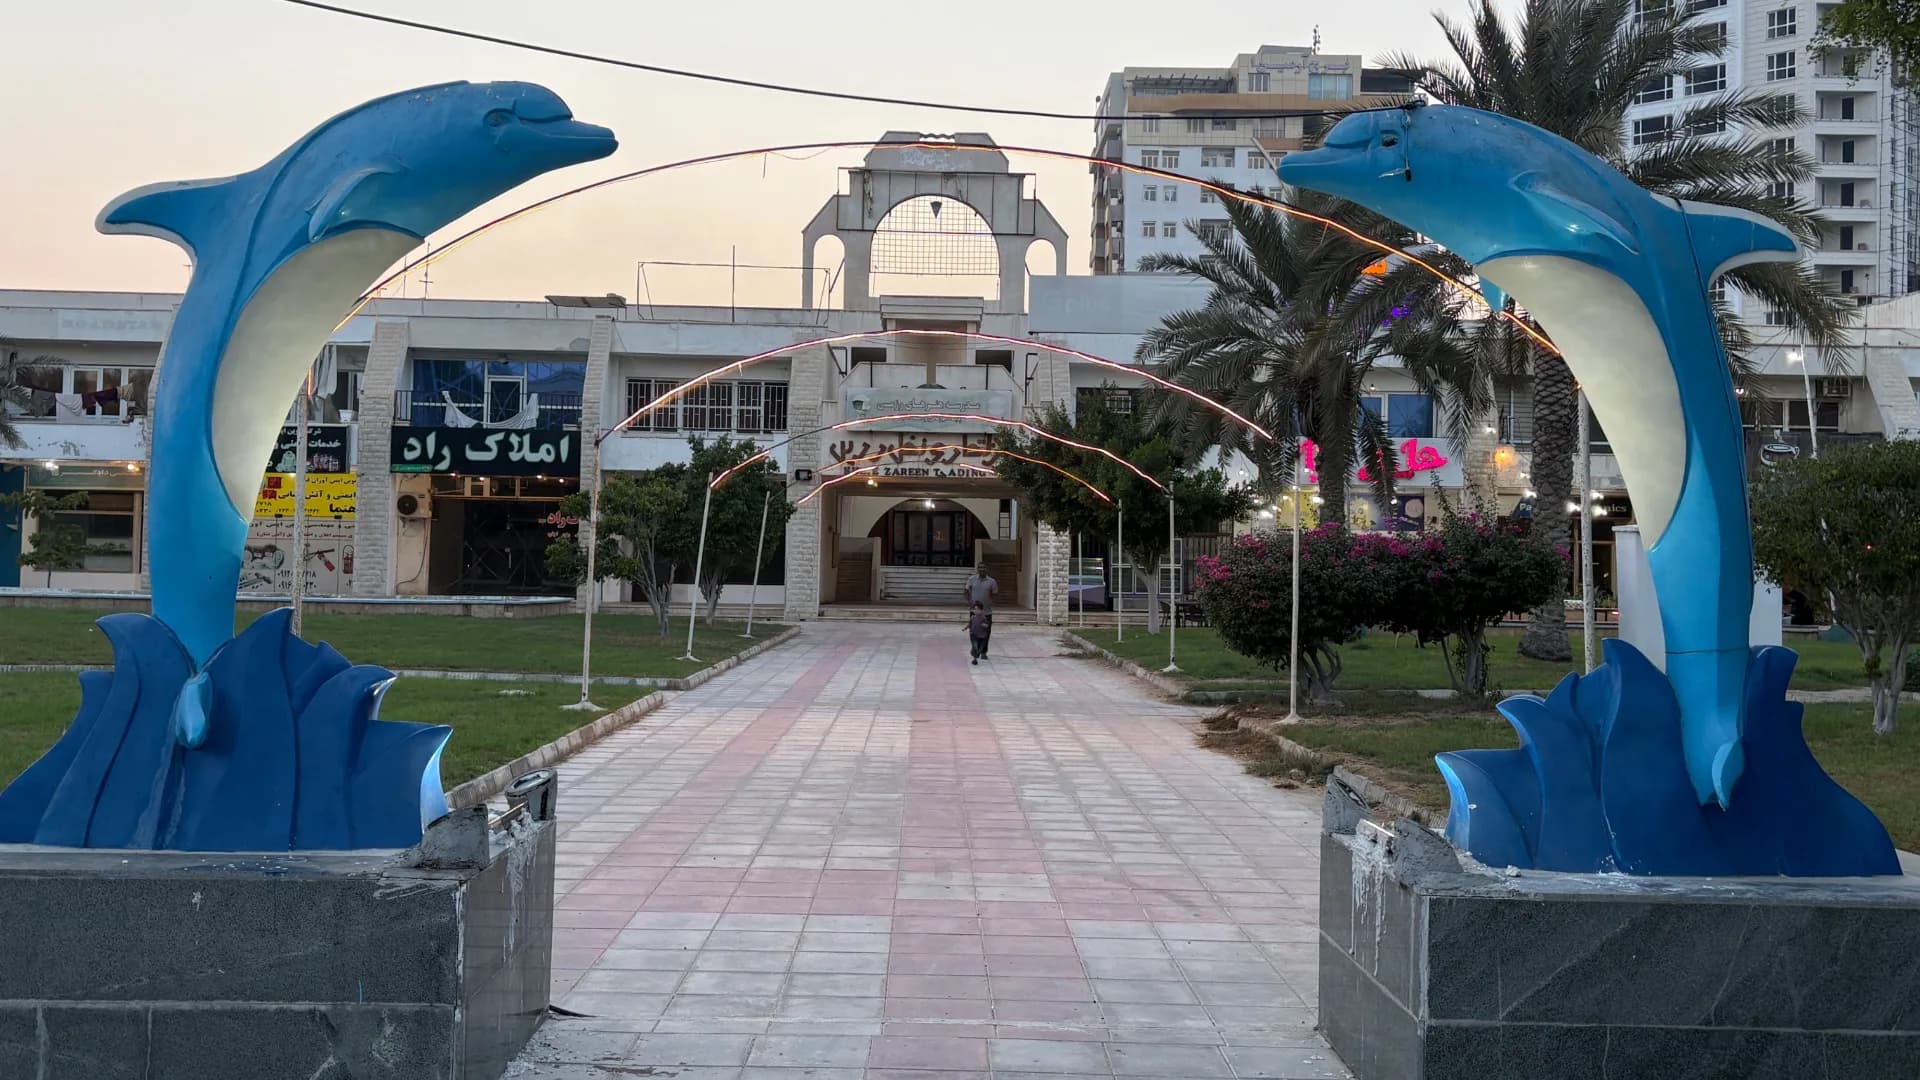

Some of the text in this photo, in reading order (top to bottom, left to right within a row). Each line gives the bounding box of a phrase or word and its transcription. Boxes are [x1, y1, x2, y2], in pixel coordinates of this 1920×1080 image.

[403, 430, 570, 471] املاک راد
[884, 467, 931, 476] ZAREEN
